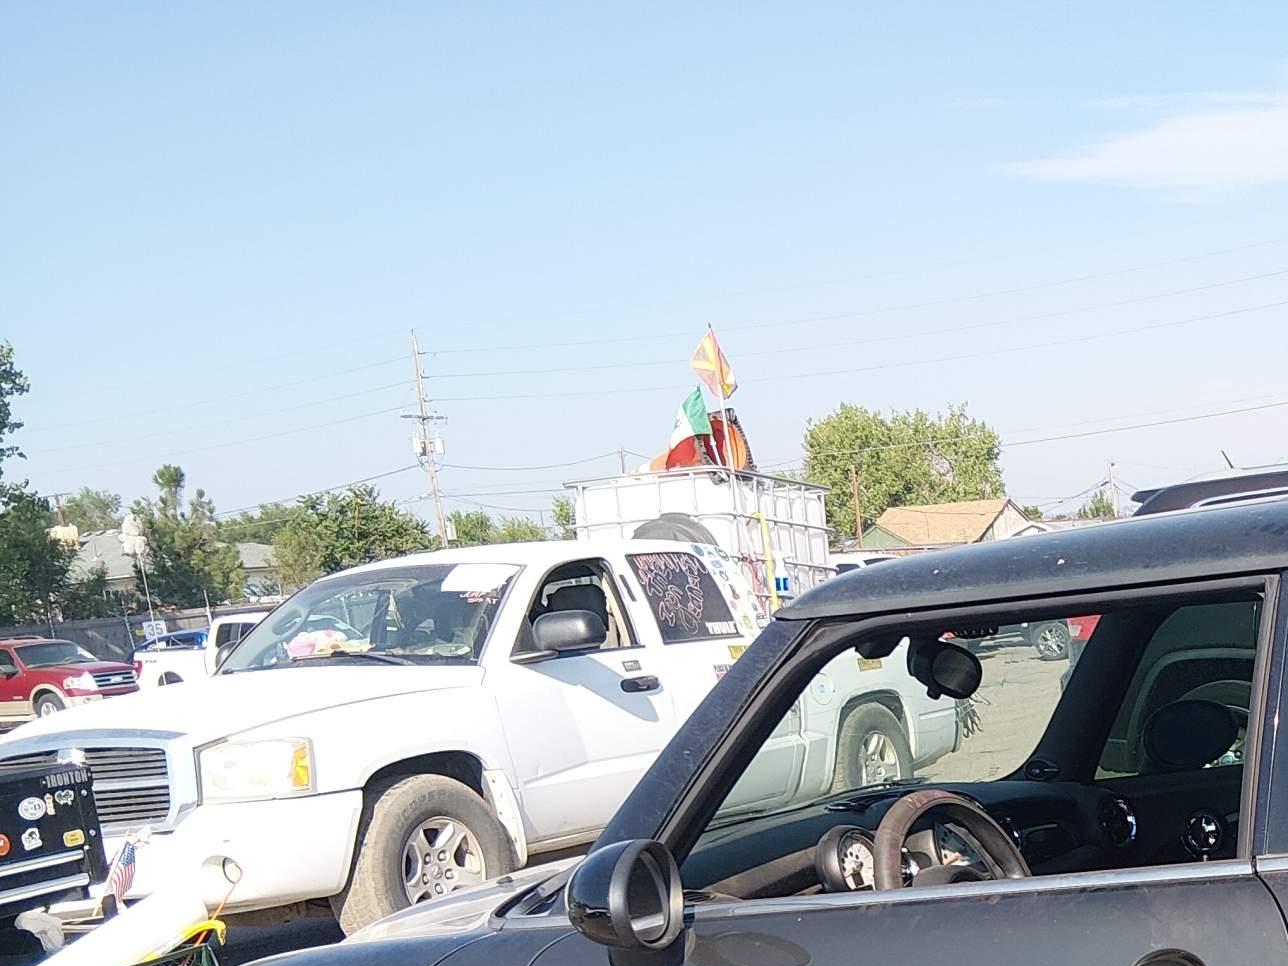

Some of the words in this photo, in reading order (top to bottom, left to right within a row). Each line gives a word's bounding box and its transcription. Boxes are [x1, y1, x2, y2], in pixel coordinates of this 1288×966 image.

[146, 623, 164, 636] 35
[705, 621, 737, 634] THULE
[45, 768, 88, 788] IRONTON
